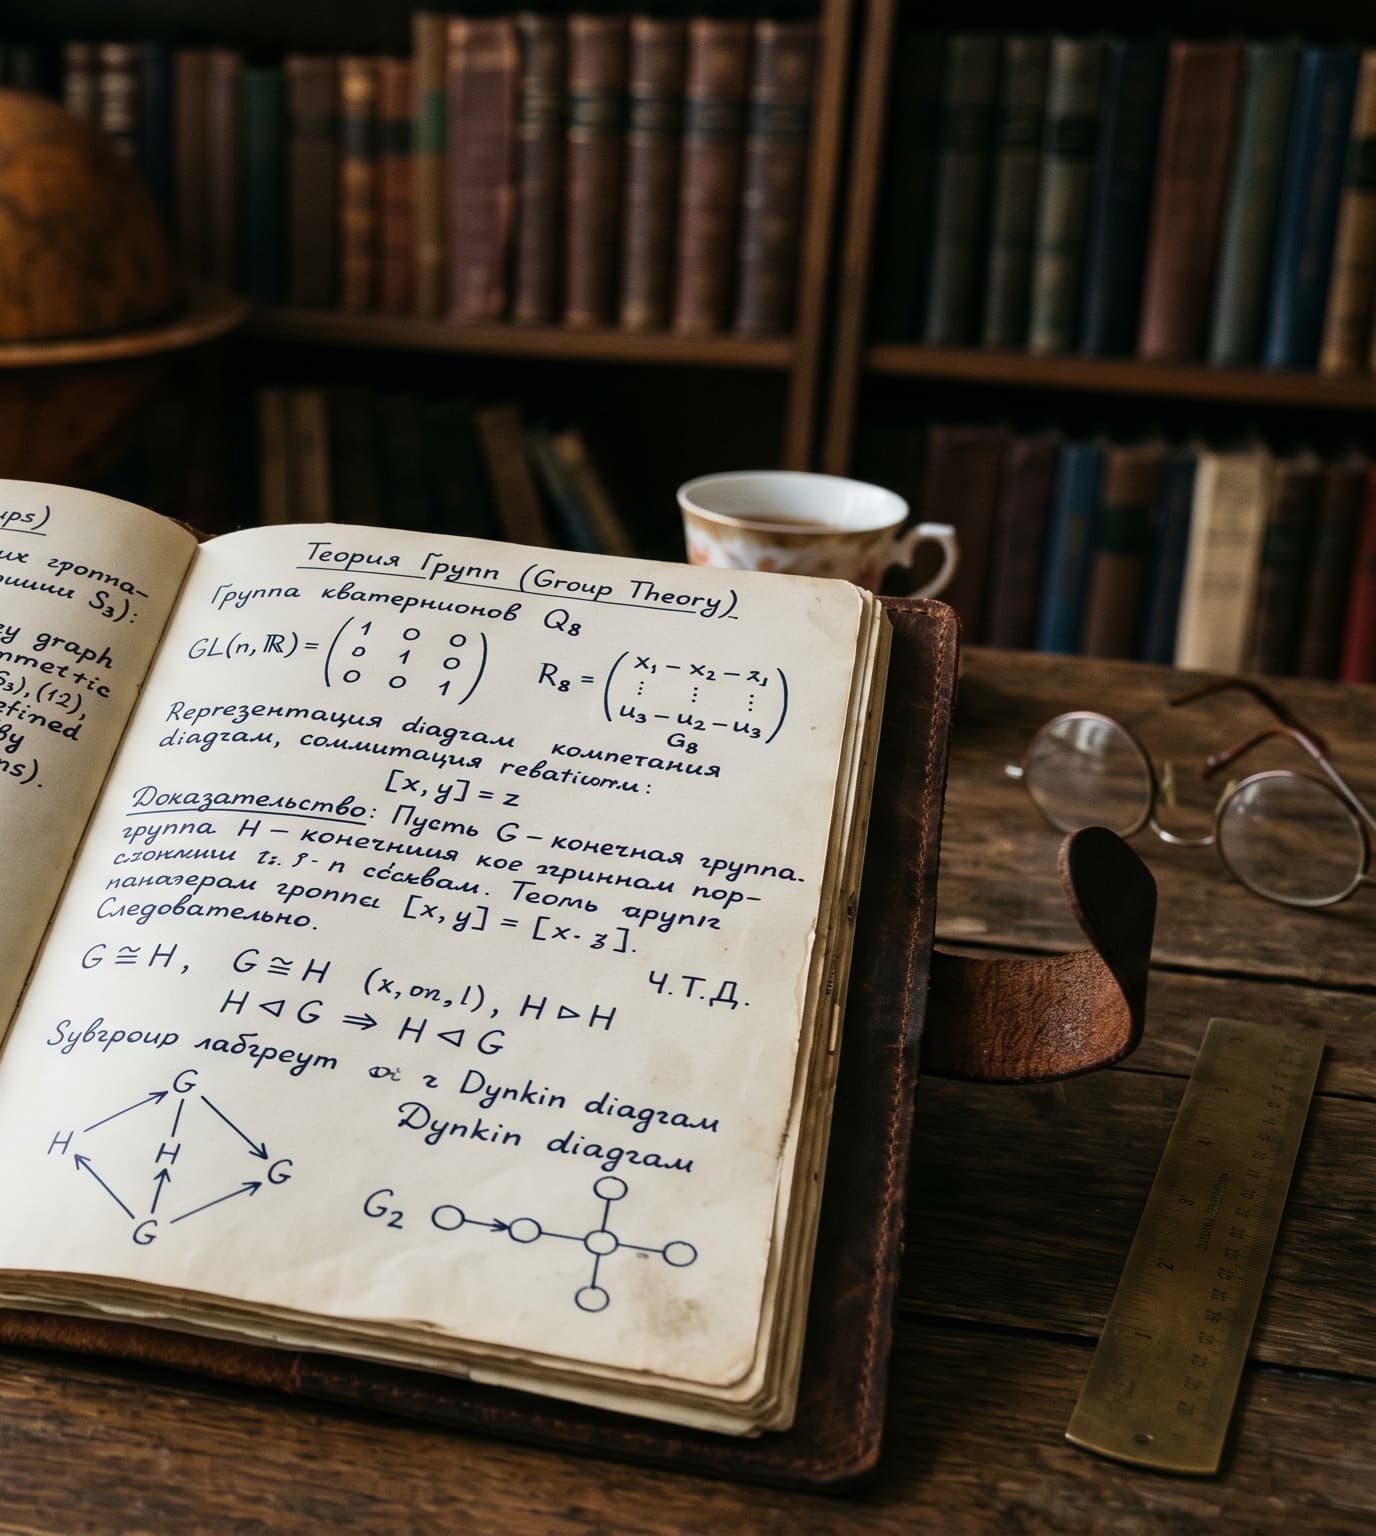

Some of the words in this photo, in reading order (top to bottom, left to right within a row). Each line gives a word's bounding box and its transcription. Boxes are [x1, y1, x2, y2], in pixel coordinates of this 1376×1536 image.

[307, 541, 401, 568] Теория
[419, 552, 500, 581] Групп
[519, 563, 613, 601] (Group
[629, 579, 739, 621] Theory)
[210, 583, 302, 611] Группа
[320, 581, 523, 622] кватернионов
[32, 632, 113, 670] graph
[121, 821, 217, 847] группа
[132, 785, 377, 819] Доказательство:
[390, 803, 480, 838] Пусть
[549, 835, 685, 866] конечная
[96, 893, 318, 931] Следовательно.
[172, 1068, 199, 1094] G
[458, 1068, 567, 1110] Dynkin
[397, 1101, 522, 1147] Dynkin
[266, 1158, 294, 1186] G
[131, 1218, 159, 1246] G
